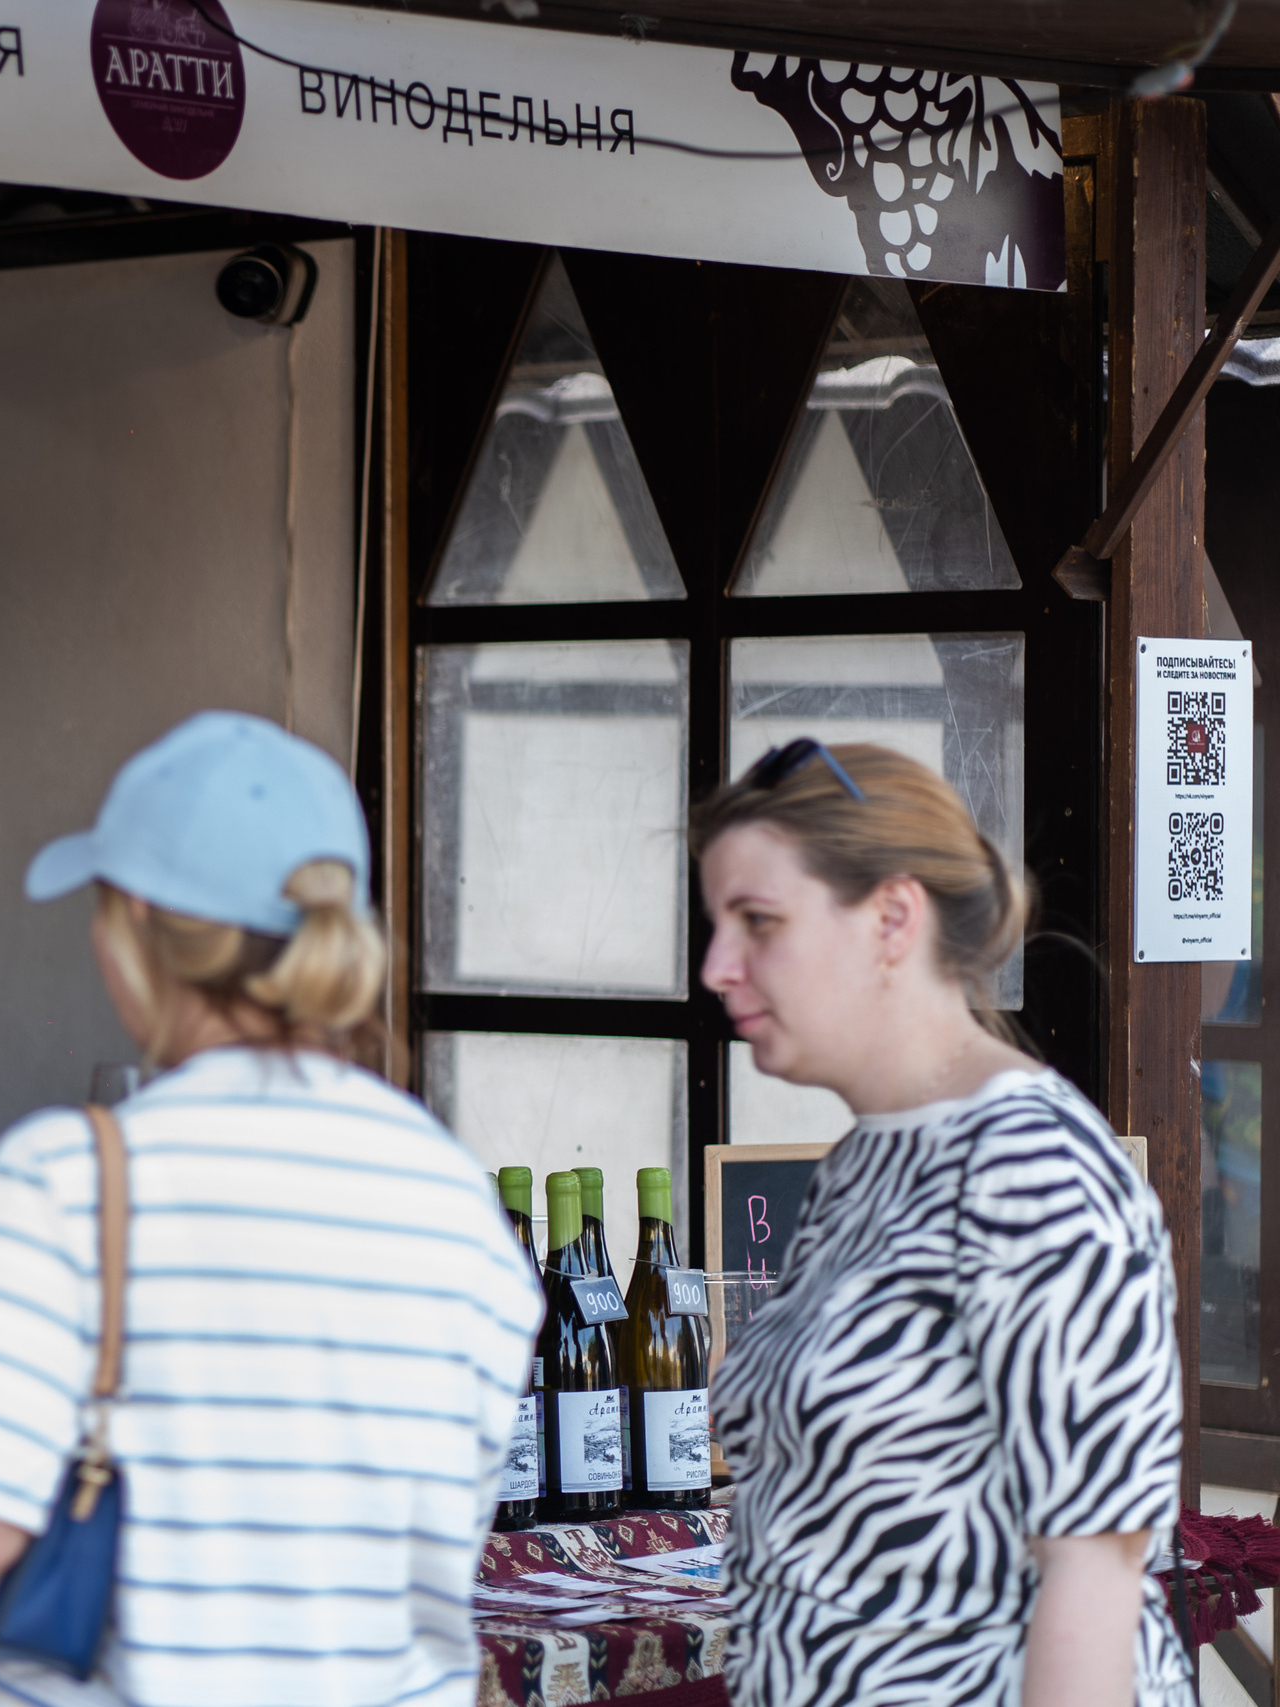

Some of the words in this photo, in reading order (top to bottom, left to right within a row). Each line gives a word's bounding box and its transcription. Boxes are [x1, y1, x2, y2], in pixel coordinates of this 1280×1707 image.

[105, 45, 235, 99] АРАТТИ
[299, 66, 636, 156] ВИНОДЕЛЬНЯ
[1156, 655, 1237, 669] ПОДПИСЫВАЙТЕСЬ!
[1156, 670, 1162, 679] И
[1163, 670, 1190, 680] СЛЕДИТЕ
[1191, 671, 1199, 679] ЗА
[1200, 671, 1237, 681] НОВОСТЯМИ
[586, 1290, 619, 1316] 900
[673, 1282, 701, 1305] 900
[509, 1479, 537, 1490] ШАРДОНЕ
